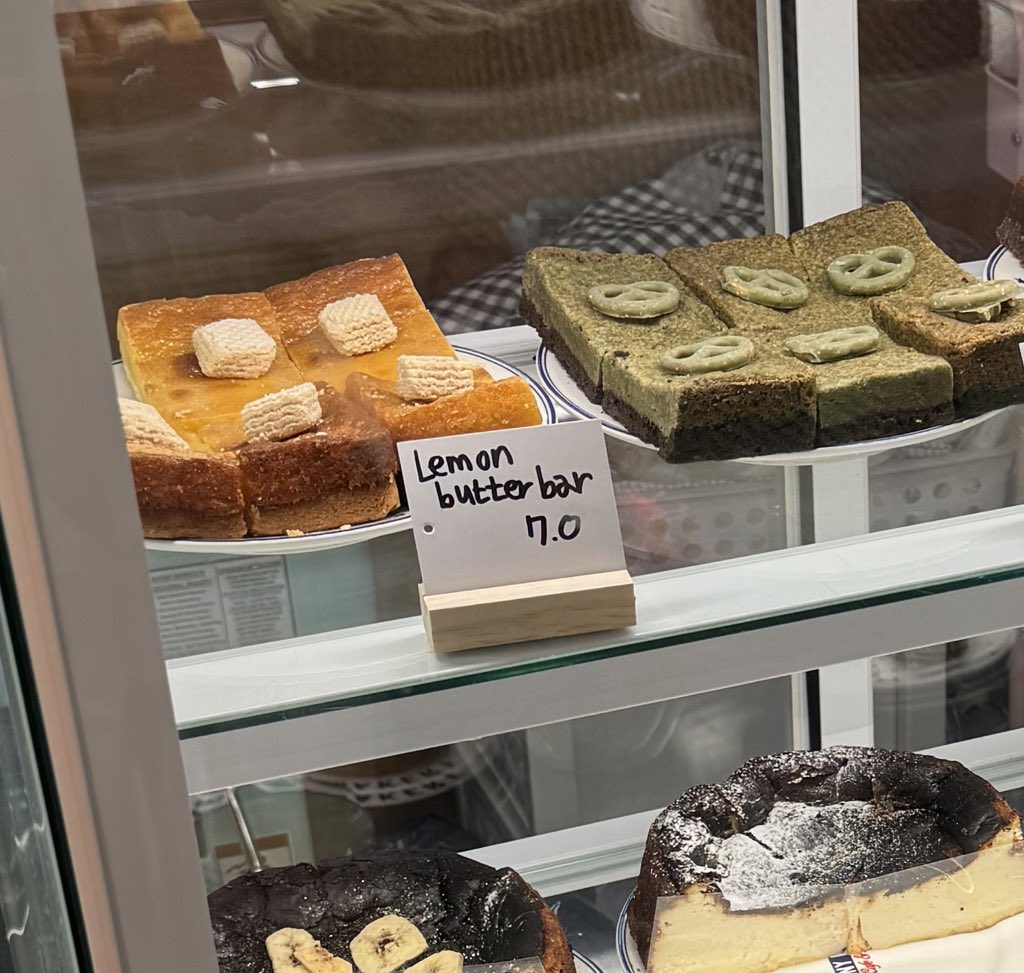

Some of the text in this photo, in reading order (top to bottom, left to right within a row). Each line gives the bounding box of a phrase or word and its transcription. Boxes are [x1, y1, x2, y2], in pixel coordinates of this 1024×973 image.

[413, 445, 514, 483] Lemon
[434, 465, 593, 509] butter bar
[525, 515, 581, 546] 7.0
